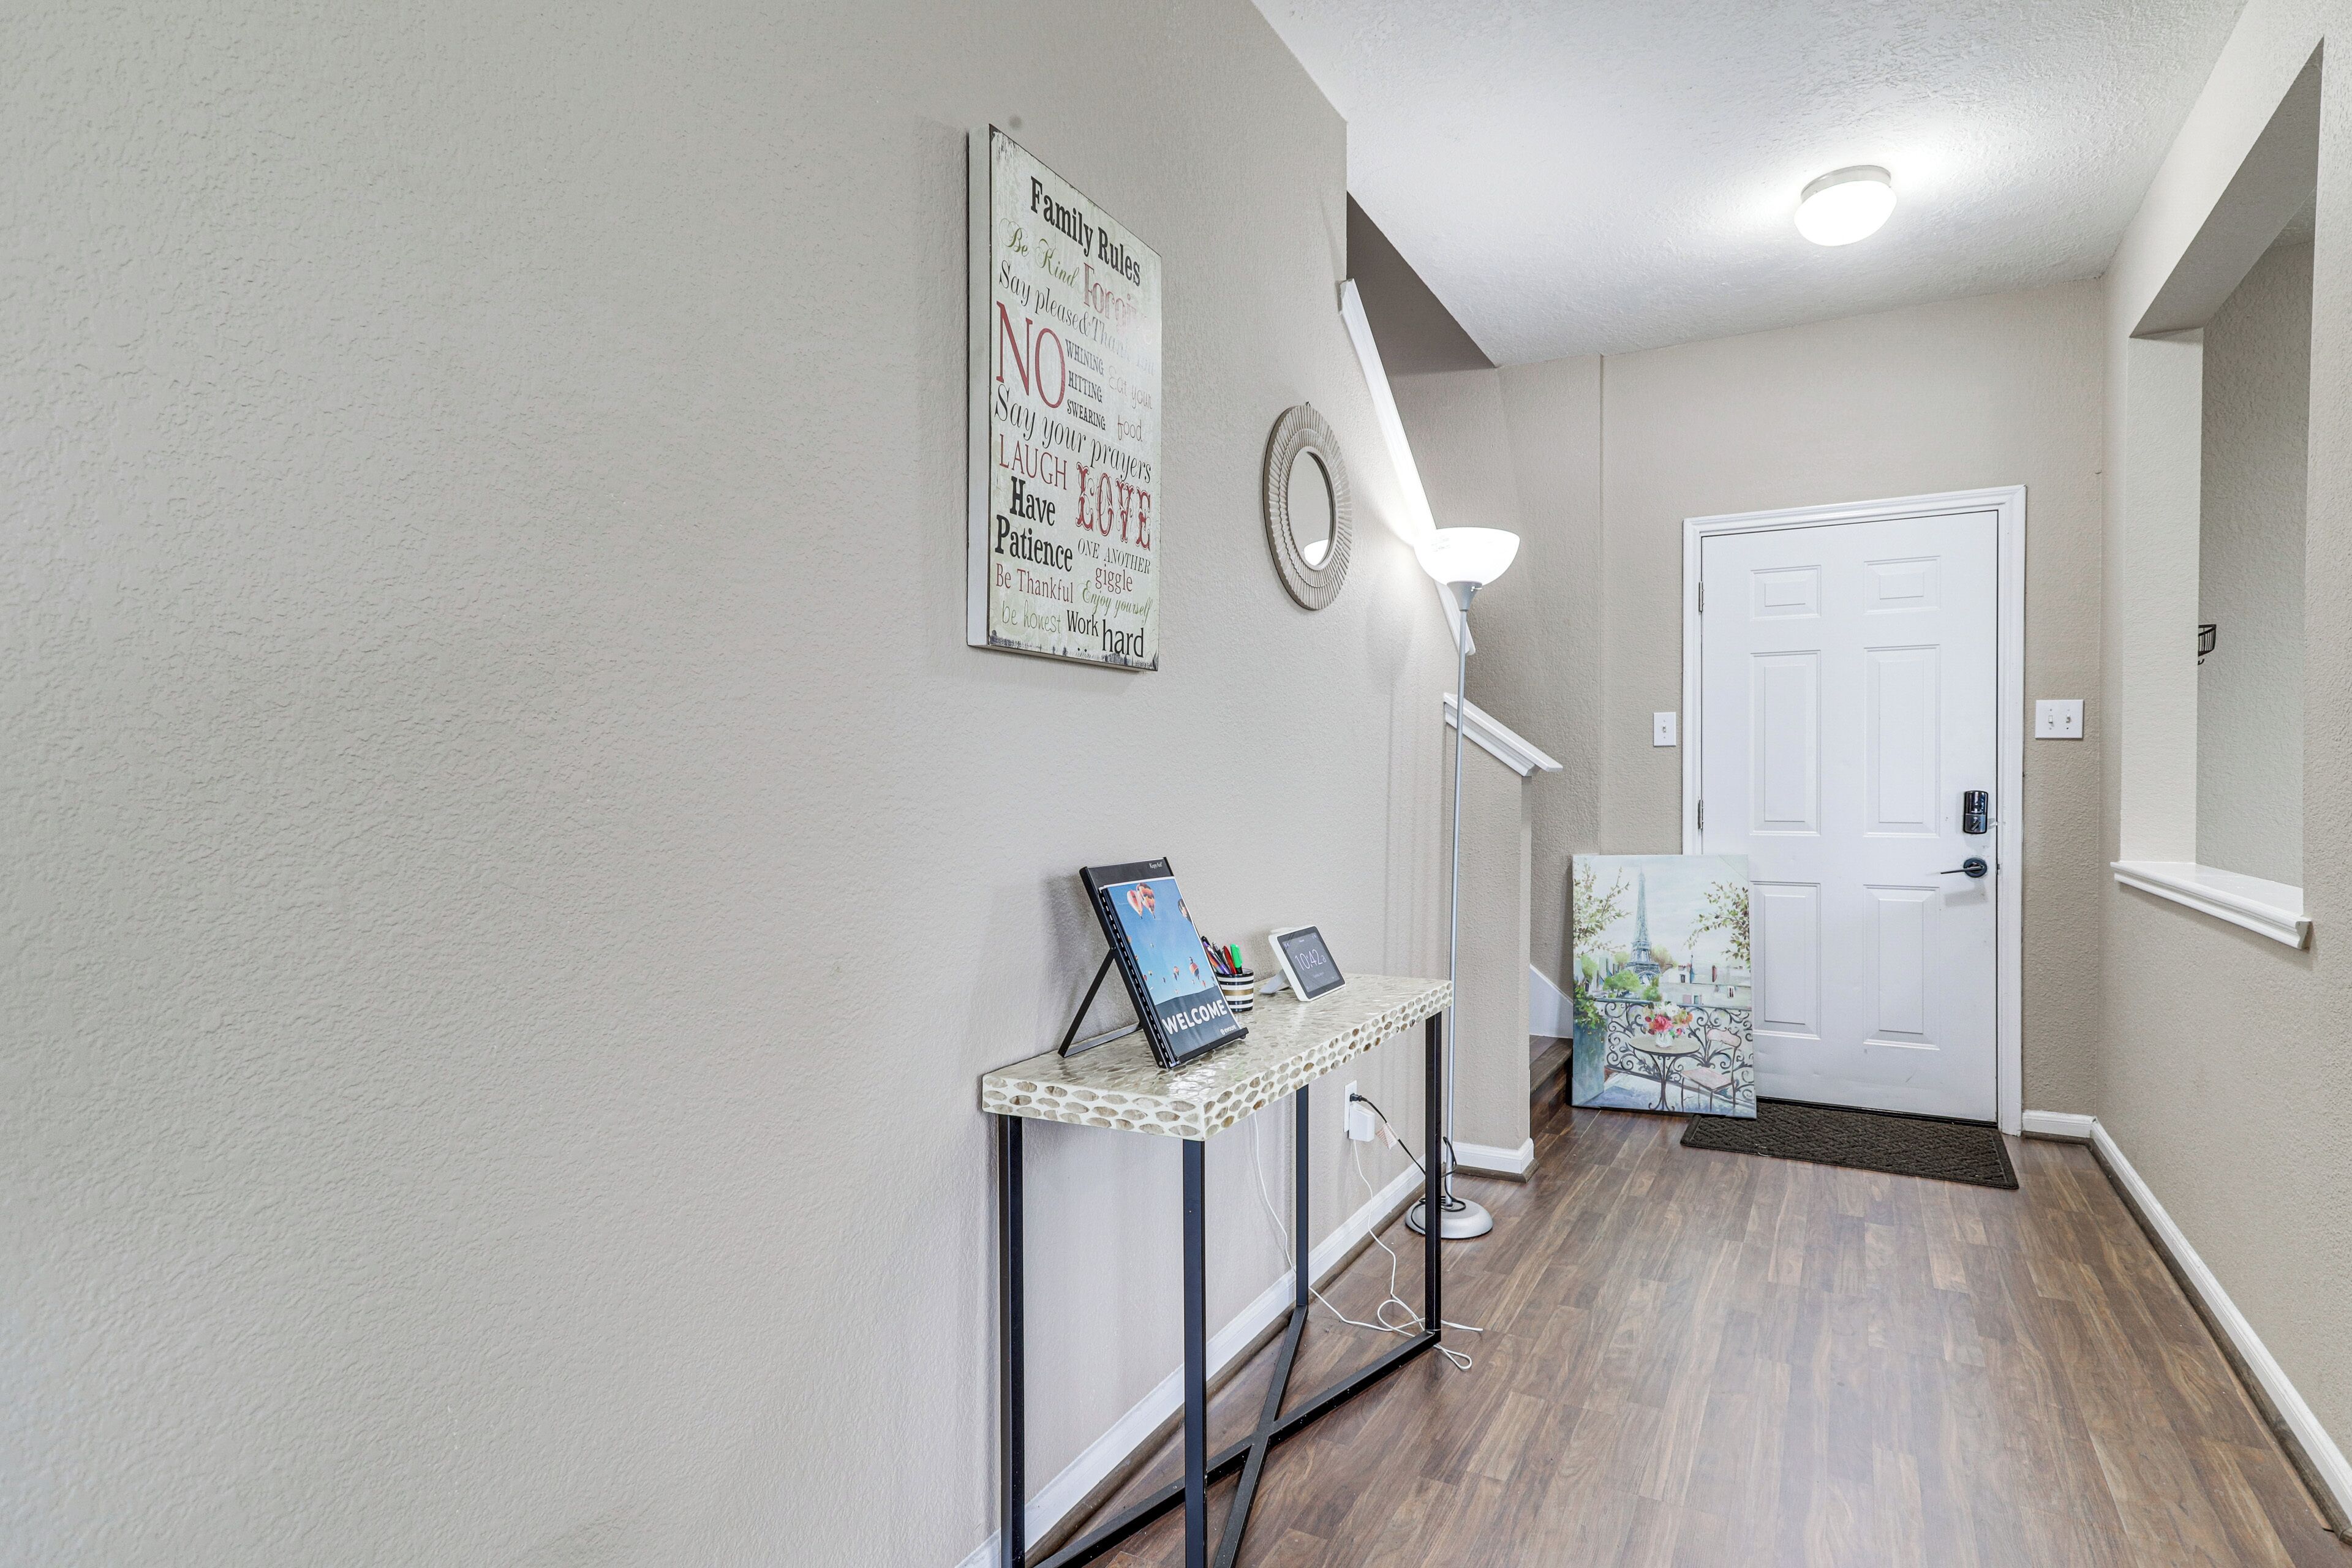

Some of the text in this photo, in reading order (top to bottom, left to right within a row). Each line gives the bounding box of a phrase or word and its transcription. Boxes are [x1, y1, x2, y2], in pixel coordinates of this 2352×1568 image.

[999, 217, 1080, 288] Be Kind
[1030, 175, 1140, 287] Family Rules
[999, 260, 1030, 307] Say
[996, 300, 1066, 409] NO
[1065, 338, 1104, 376] WHINING
[1068, 370, 1102, 404] HITTING
[1108, 365, 1152, 410] Eat your
[994, 383, 1152, 483] Say your prayers
[1067, 399, 1106, 431] SWEARING
[1117, 414, 1143, 442] food
[999, 434, 1067, 490] LAUGH
[1009, 476, 1055, 526] Have
[1076, 461, 1152, 551] LOVE
[995, 514, 1073, 571] Patience
[1077, 537, 1151, 575] ONE ANOTHER
[995, 563, 1074, 603] Be Thankful
[1095, 564, 1133, 594] giggle
[1001, 599, 1061, 633] be honest
[1078, 580, 1153, 625] Enjoy yourself
[1066, 609, 1144, 658] Work hard
[1161, 999, 1227, 1035] WELCOME
